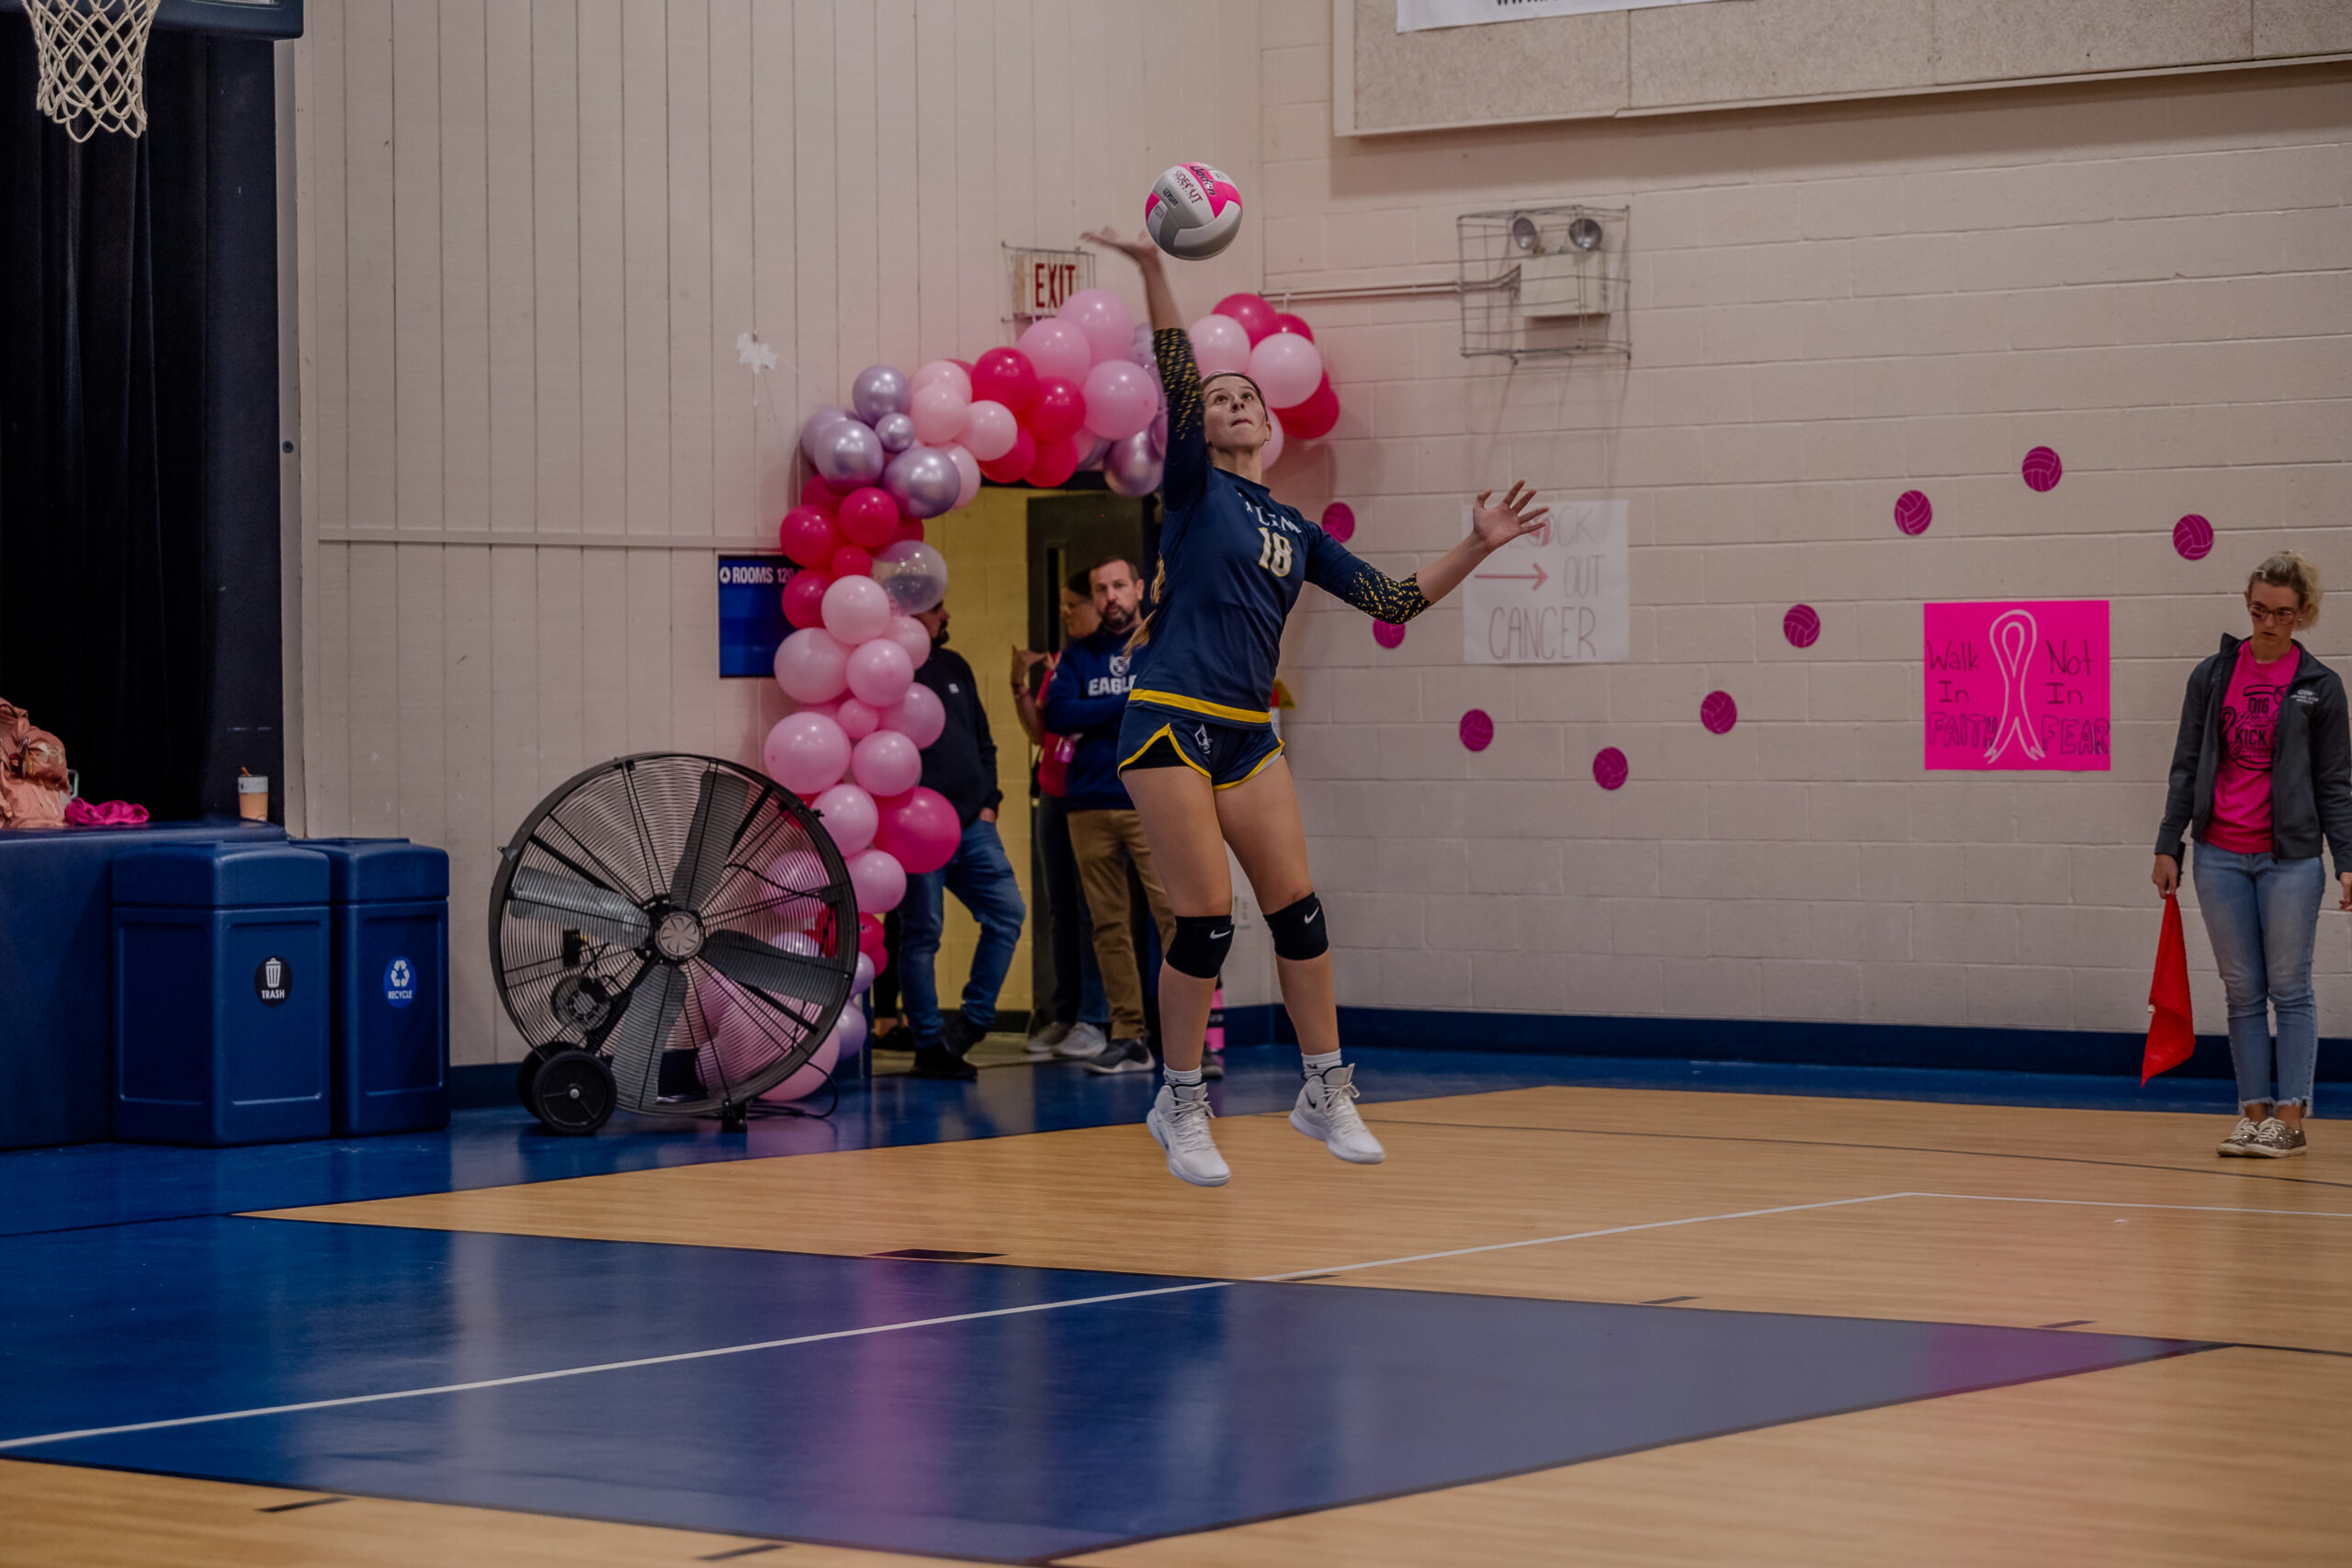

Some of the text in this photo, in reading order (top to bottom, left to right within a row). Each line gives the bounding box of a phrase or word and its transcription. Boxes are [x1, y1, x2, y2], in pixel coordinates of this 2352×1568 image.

[1035, 263, 1076, 309] EXIT
[1258, 526, 1293, 577] 18
[732, 566, 775, 584] ROOMS
[1564, 555, 1606, 598] OUT
[1488, 605, 1597, 660] CANCER
[1927, 639, 1980, 672] Walk
[2045, 639, 2095, 675] Not
[1938, 680, 1971, 704] In
[2045, 682, 2084, 705] In
[2248, 696, 2270, 715] DIG
[1928, 711, 1998, 750] FAITH
[2041, 714, 2111, 756] FEAR
[2234, 727, 2267, 747] KICK
[262, 989, 285, 999] TRASH
[388, 989, 413, 999] RECYCLE
